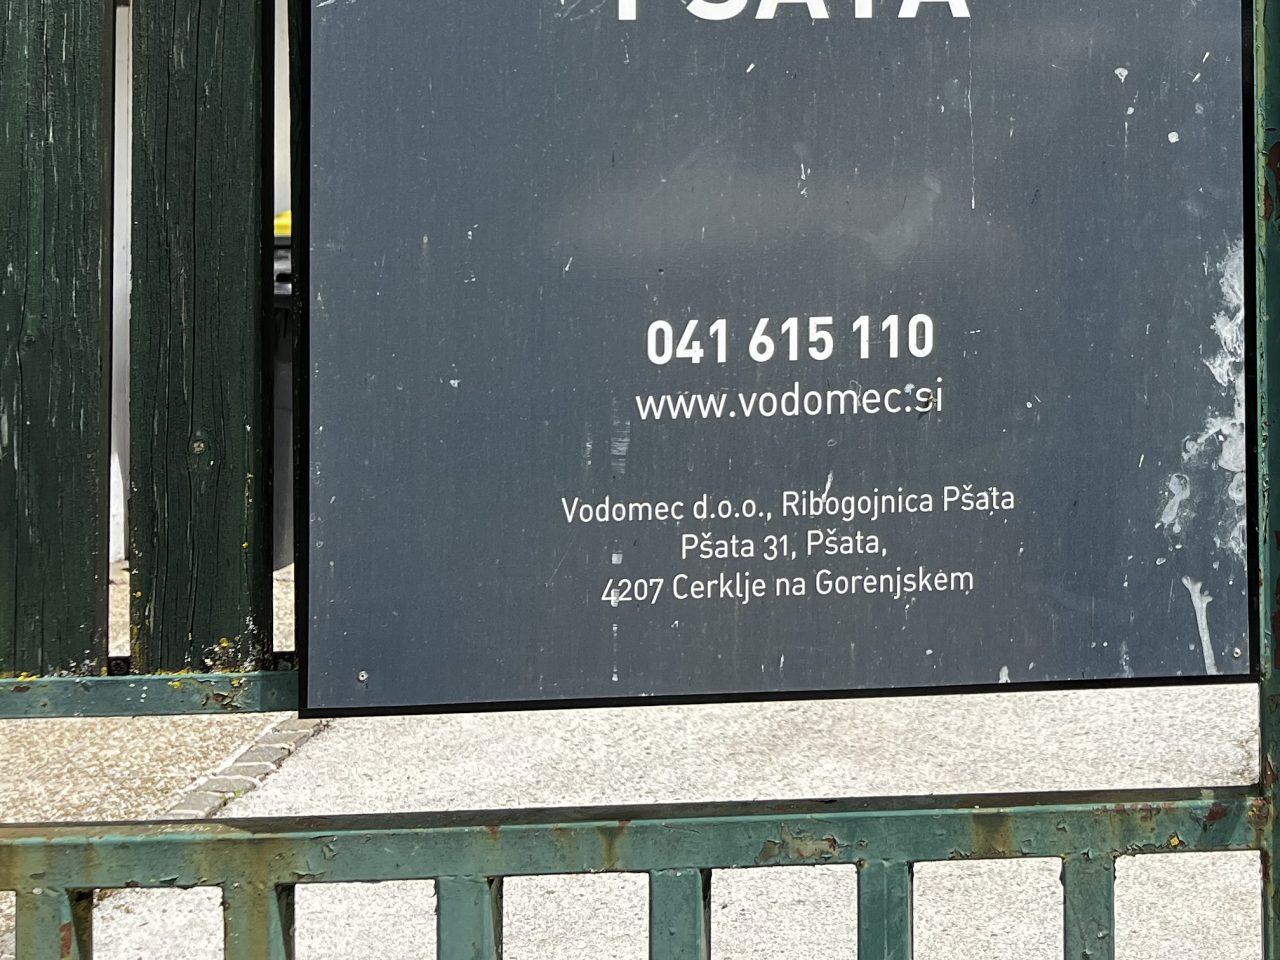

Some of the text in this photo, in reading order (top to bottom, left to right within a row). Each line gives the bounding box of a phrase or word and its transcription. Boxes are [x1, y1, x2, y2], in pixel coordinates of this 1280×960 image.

[646, 313, 934, 366] 041 615 110
[635, 376, 943, 421] www.vodomec.si
[561, 485, 1015, 523] Vodomec d.o.o., Ribogojnica Pšata
[682, 529, 888, 562] Pšata 31, Pšata,
[601, 566, 975, 605] 4207 Cerklje na Gorenjskem
